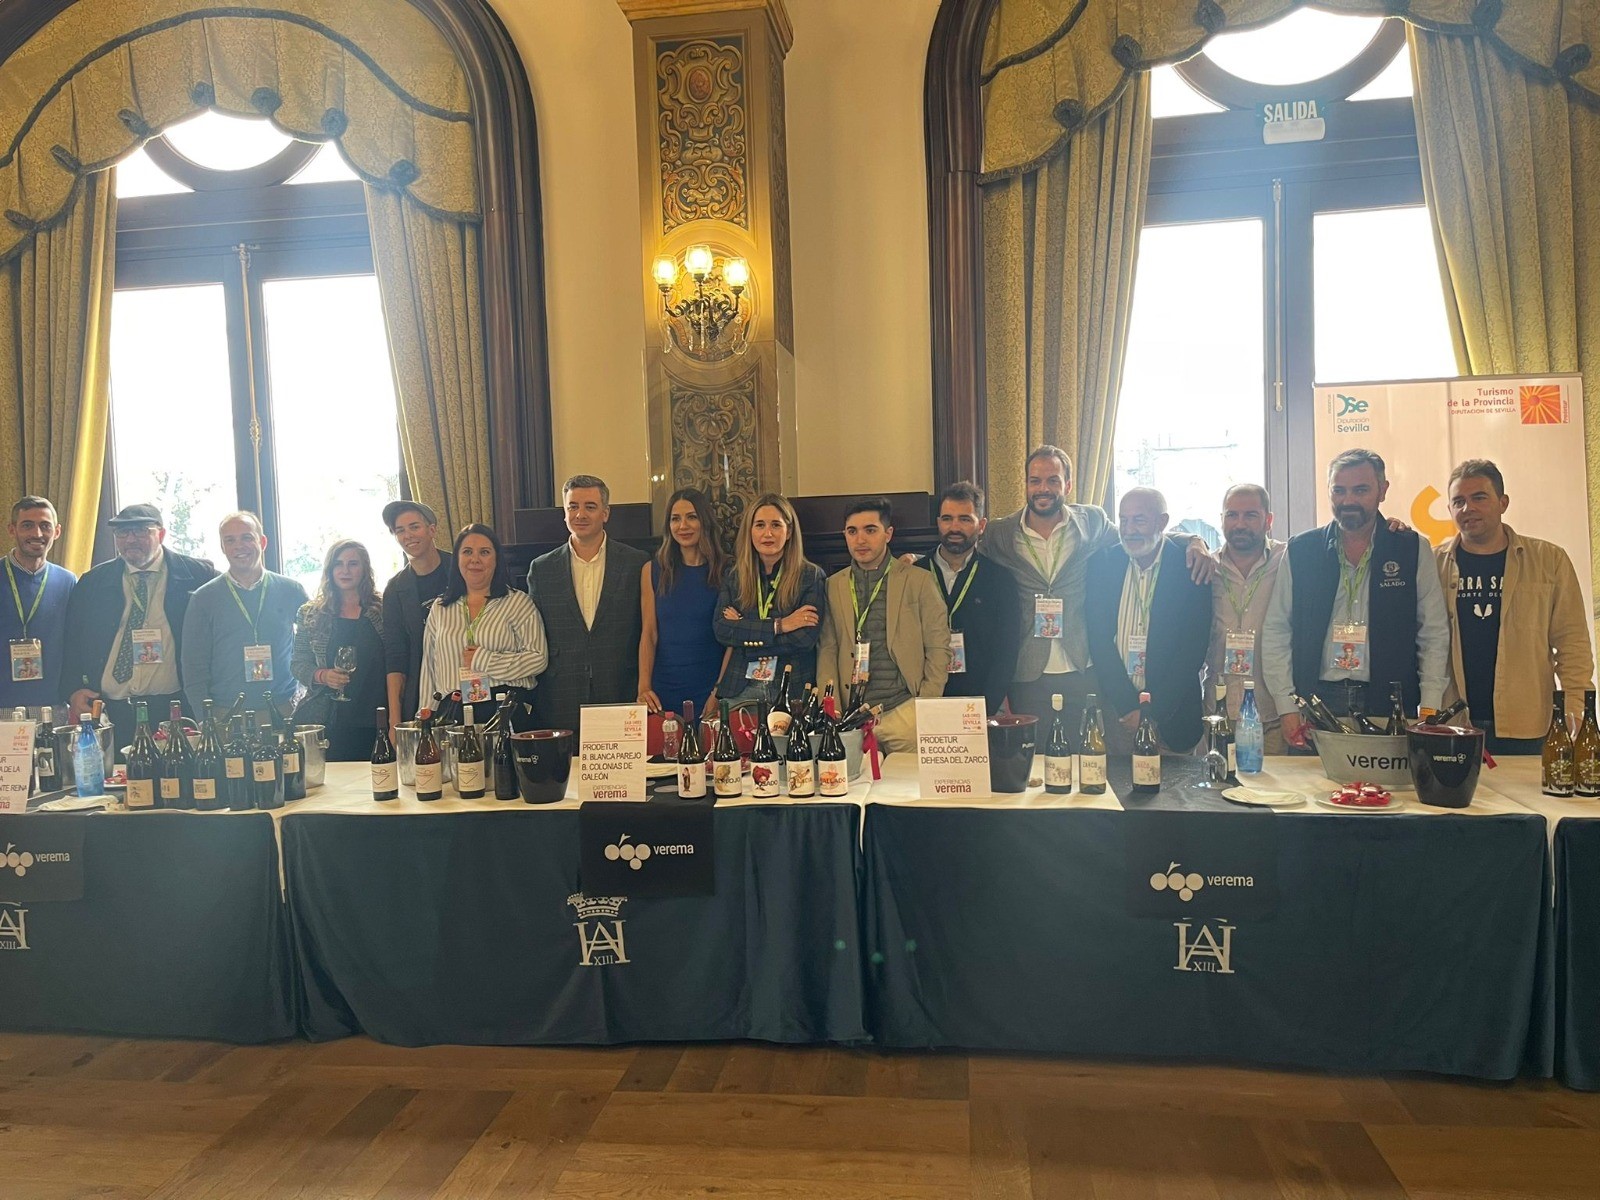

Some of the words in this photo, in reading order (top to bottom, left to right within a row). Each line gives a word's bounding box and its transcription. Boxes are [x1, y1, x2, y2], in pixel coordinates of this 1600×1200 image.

[1264, 100, 1317, 123] SALIDA
[1477, 387, 1514, 396] Turismo
[1447, 399, 1458, 407] de
[1461, 398, 1470, 407] la
[1473, 396, 1514, 406] Provincia
[1337, 423, 1370, 433] Sevilla
[1380, 580, 1406, 588] SALADO
[920, 736, 958, 744] PRODETUR
[582, 743, 619, 751] PRODETUR
[928, 745, 969, 754] ECOLÓGICA
[589, 752, 615, 761] BLANCA
[616, 752, 641, 760] PAREJO
[921, 756, 949, 764] DEHESA
[950, 756, 963, 764] DEL
[964, 756, 988, 764] ZARCO
[1346, 754, 1409, 770] verem
[589, 763, 623, 771] COLONIAS
[581, 772, 609, 781] GALEÓN
[11, 784, 28, 792] REINA
[934, 784, 972, 793] verema
[593, 789, 628, 799] verema
[653, 844, 695, 855] verema
[34, 853, 70, 863] verema
[1206, 876, 1254, 887] verema
[593, 955, 614, 966] XIII
[1192, 961, 1216, 973] XIII
